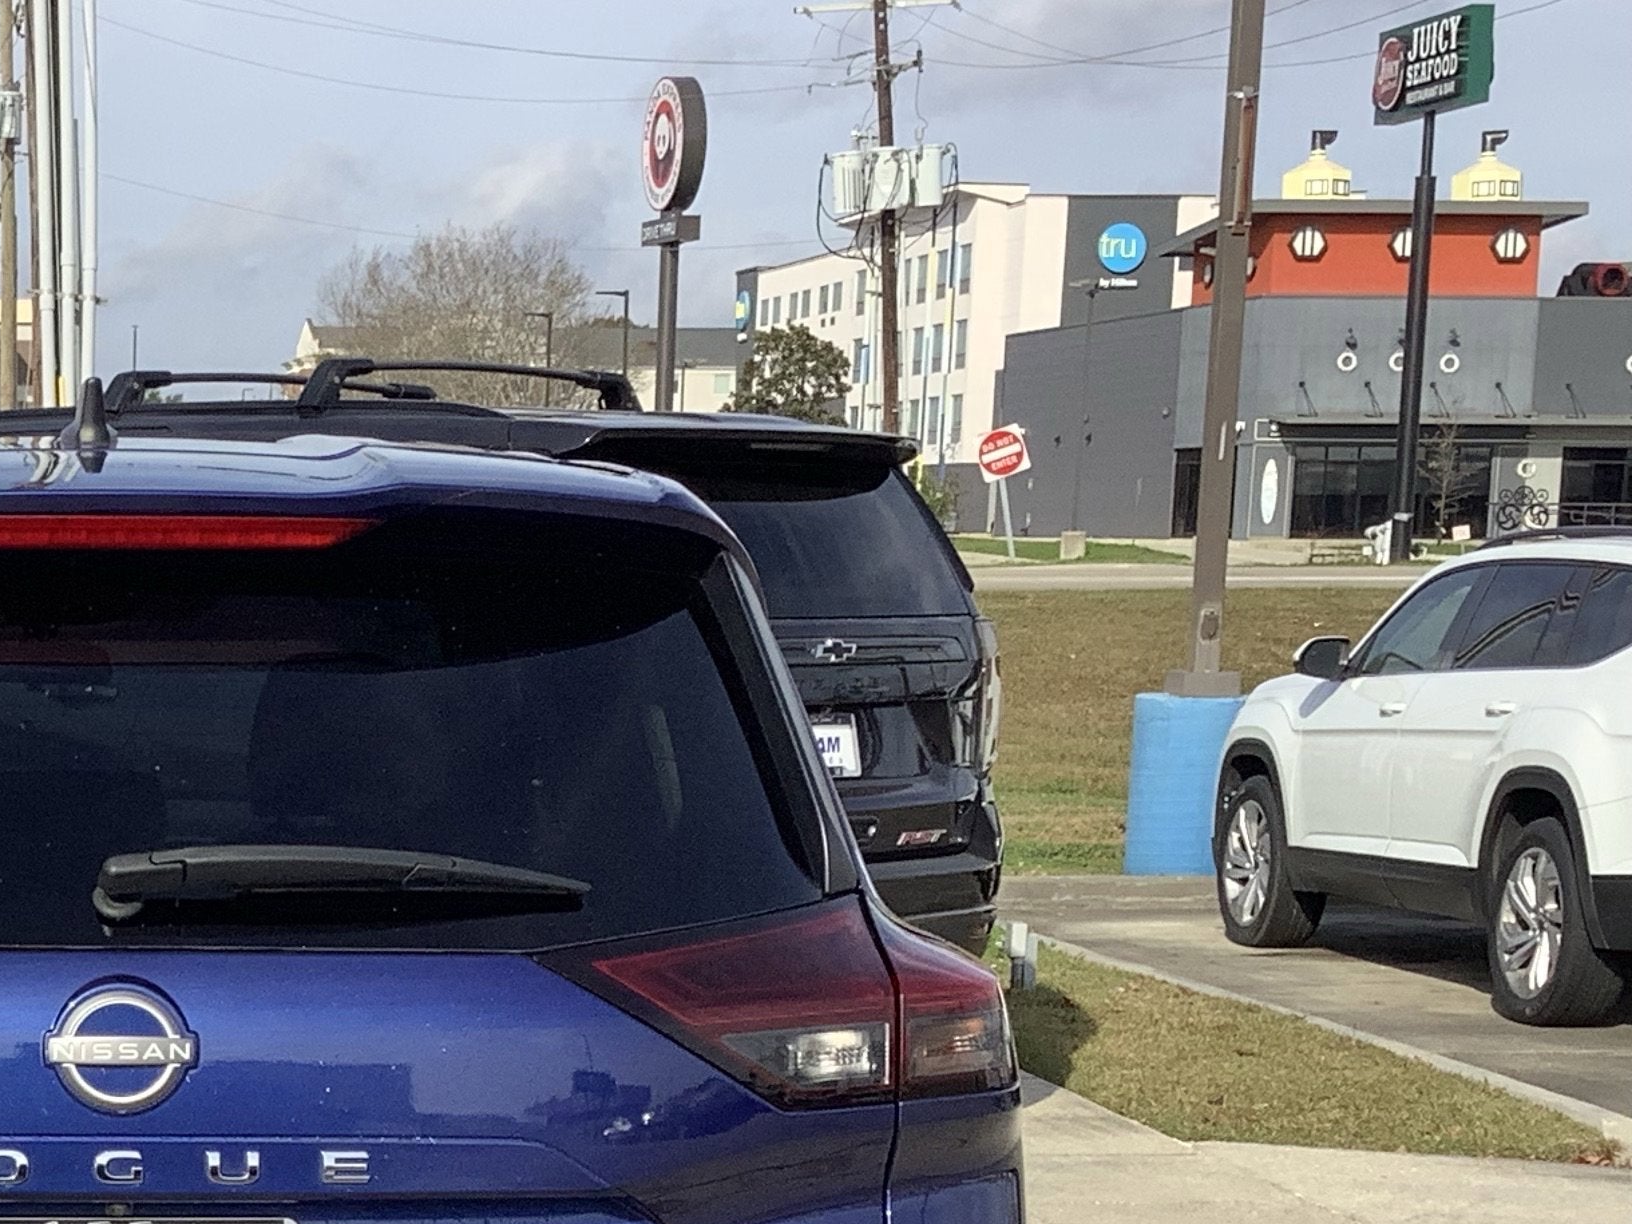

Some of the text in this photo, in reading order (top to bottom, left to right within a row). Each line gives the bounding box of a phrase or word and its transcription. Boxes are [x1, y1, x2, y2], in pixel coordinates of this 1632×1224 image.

[1408, 15, 1462, 62] JUICY
[1406, 52, 1458, 87] SEAFOOD
[1100, 233, 1137, 258] tru
[51, 1040, 192, 1061] NISSAN
